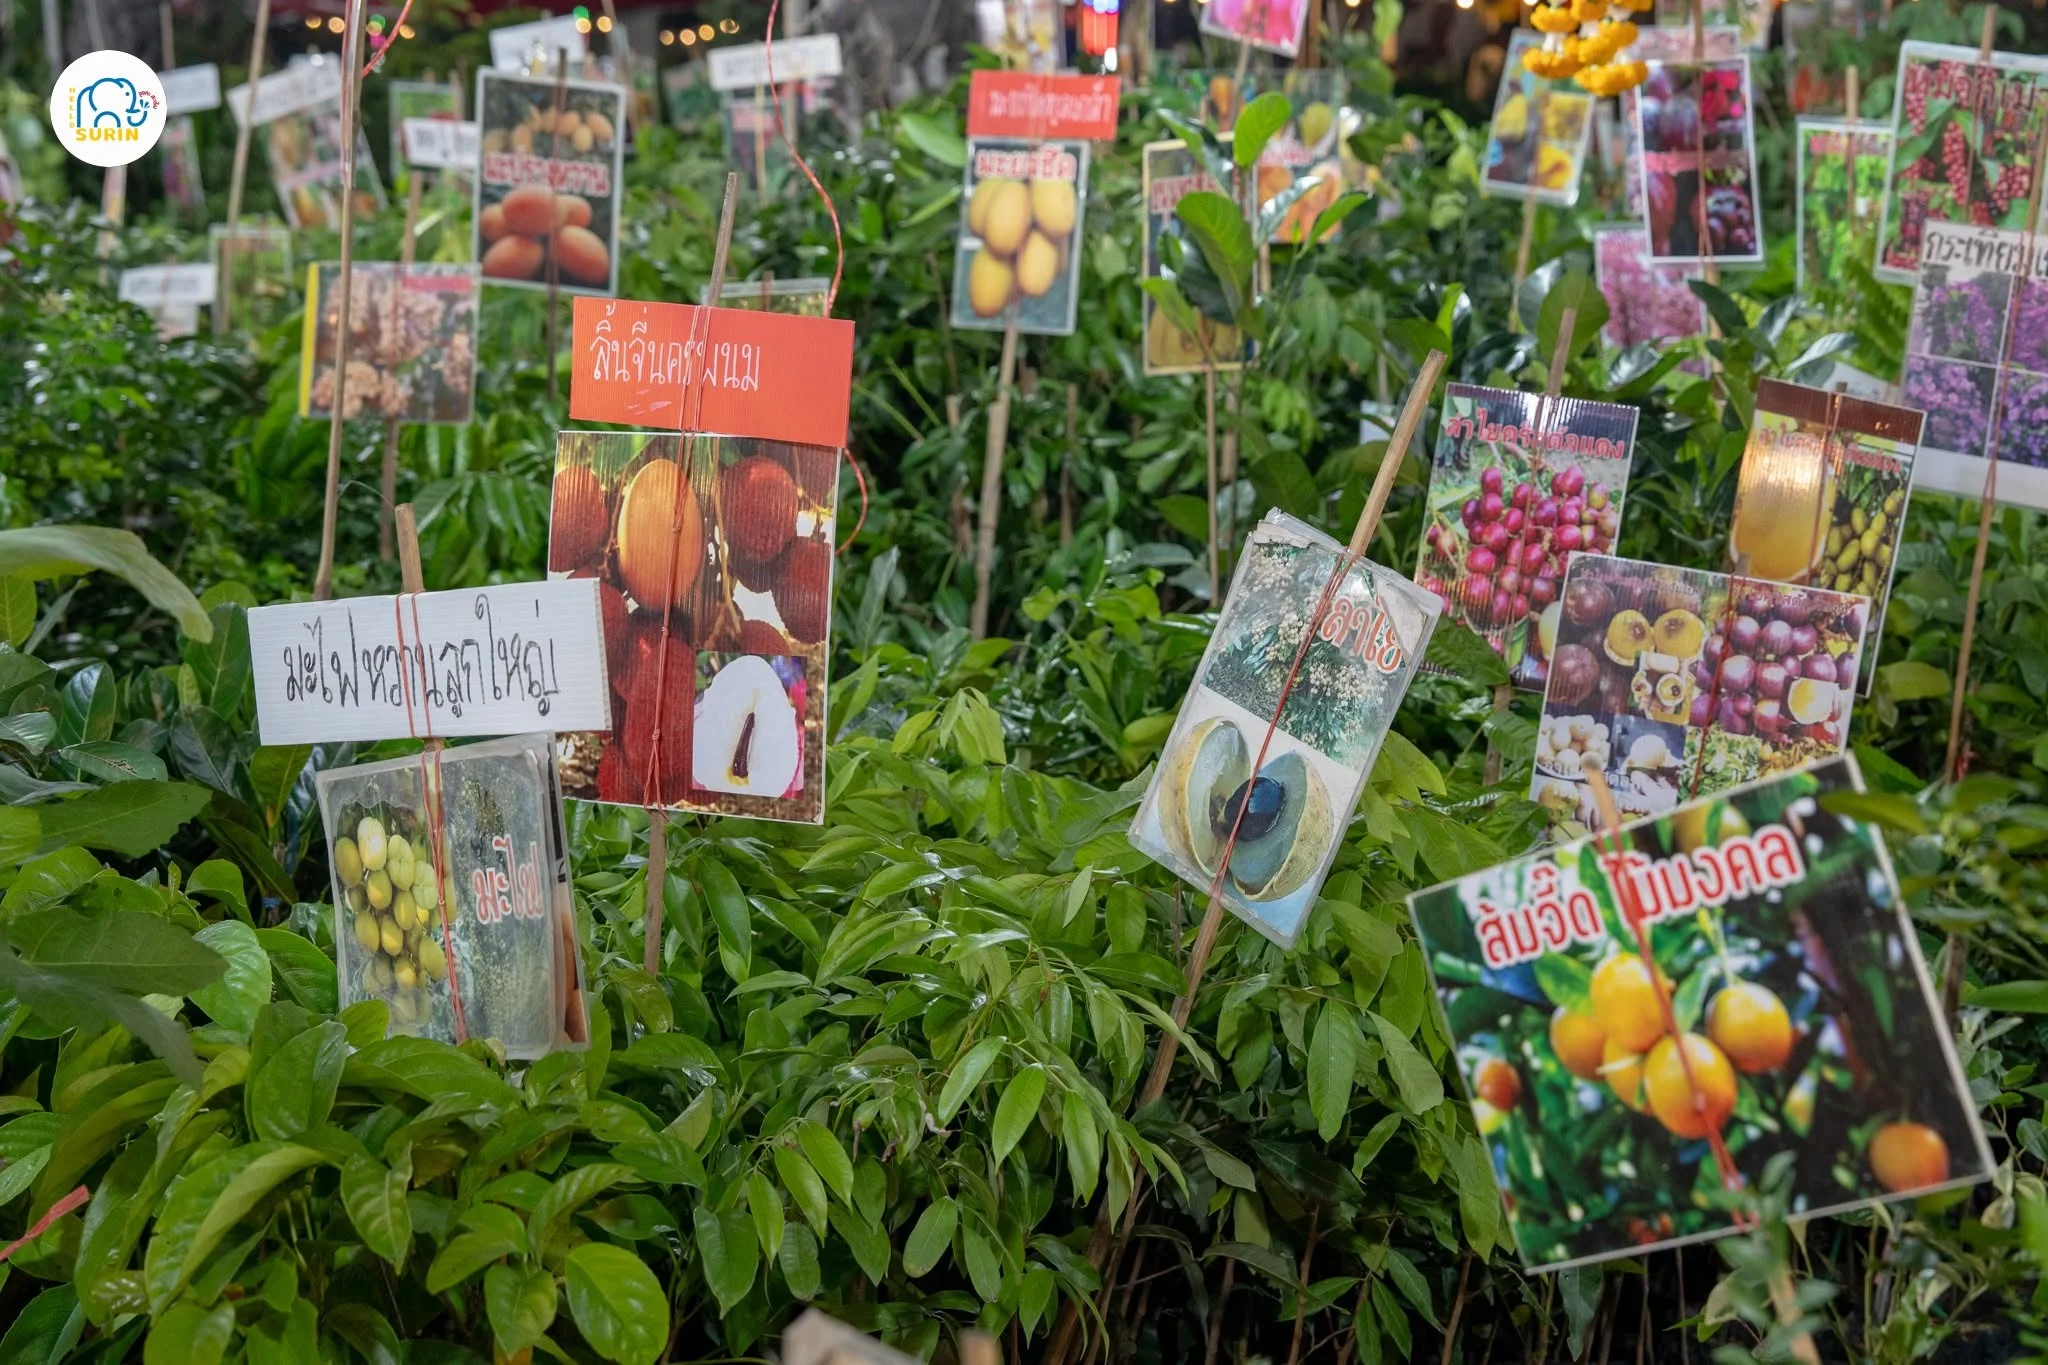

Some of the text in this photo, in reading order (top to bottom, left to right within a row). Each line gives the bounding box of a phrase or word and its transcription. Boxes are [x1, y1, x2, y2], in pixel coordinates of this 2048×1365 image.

[282, 593, 562, 719] มะไฟหวานลูกใหญ่
[474, 834, 544, 924] มะไฟ
[1476, 824, 1804, 968] ส้มจี๊ด ไม้มงคล
